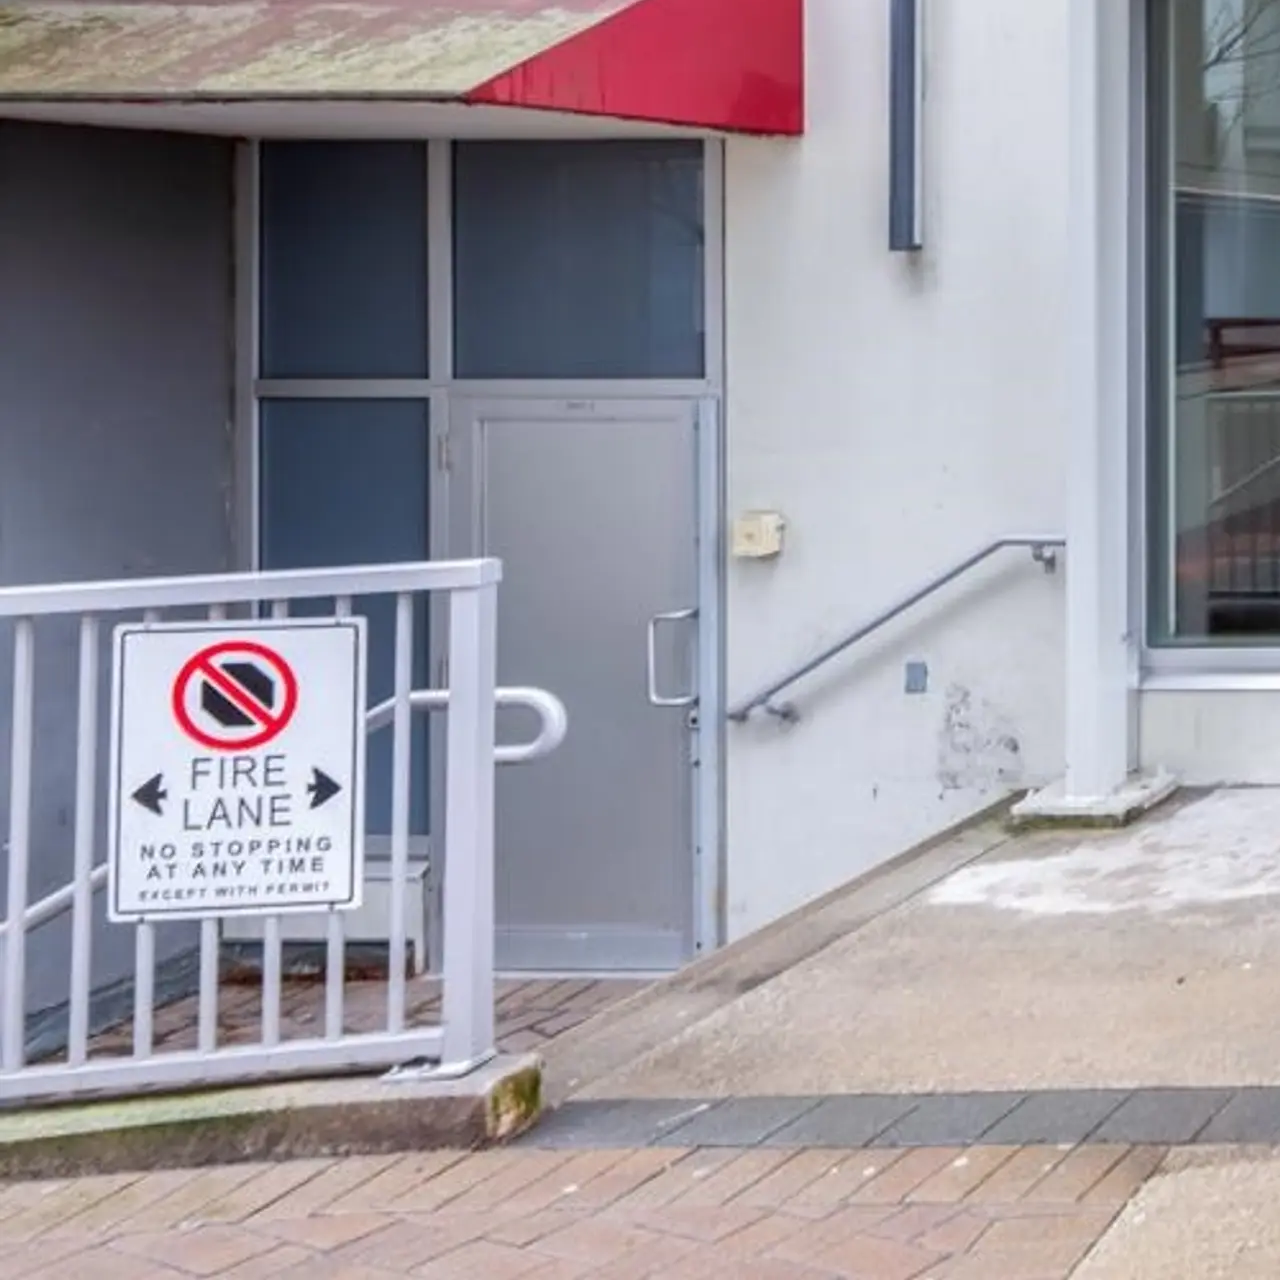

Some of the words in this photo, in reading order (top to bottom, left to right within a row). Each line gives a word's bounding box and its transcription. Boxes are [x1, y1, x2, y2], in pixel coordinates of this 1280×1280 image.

[191, 754, 287, 790] FIRE
[183, 794, 293, 831] LANE
[140, 842, 177, 861] NO
[191, 836, 333, 858] STOPPING
[146, 863, 178, 880] AT
[192, 860, 247, 879] ANY
[260, 856, 325, 875] TIME
[138, 888, 208, 902] EXCEPT
[214, 885, 258, 898] WITH
[265, 880, 331, 895] PERMIT
